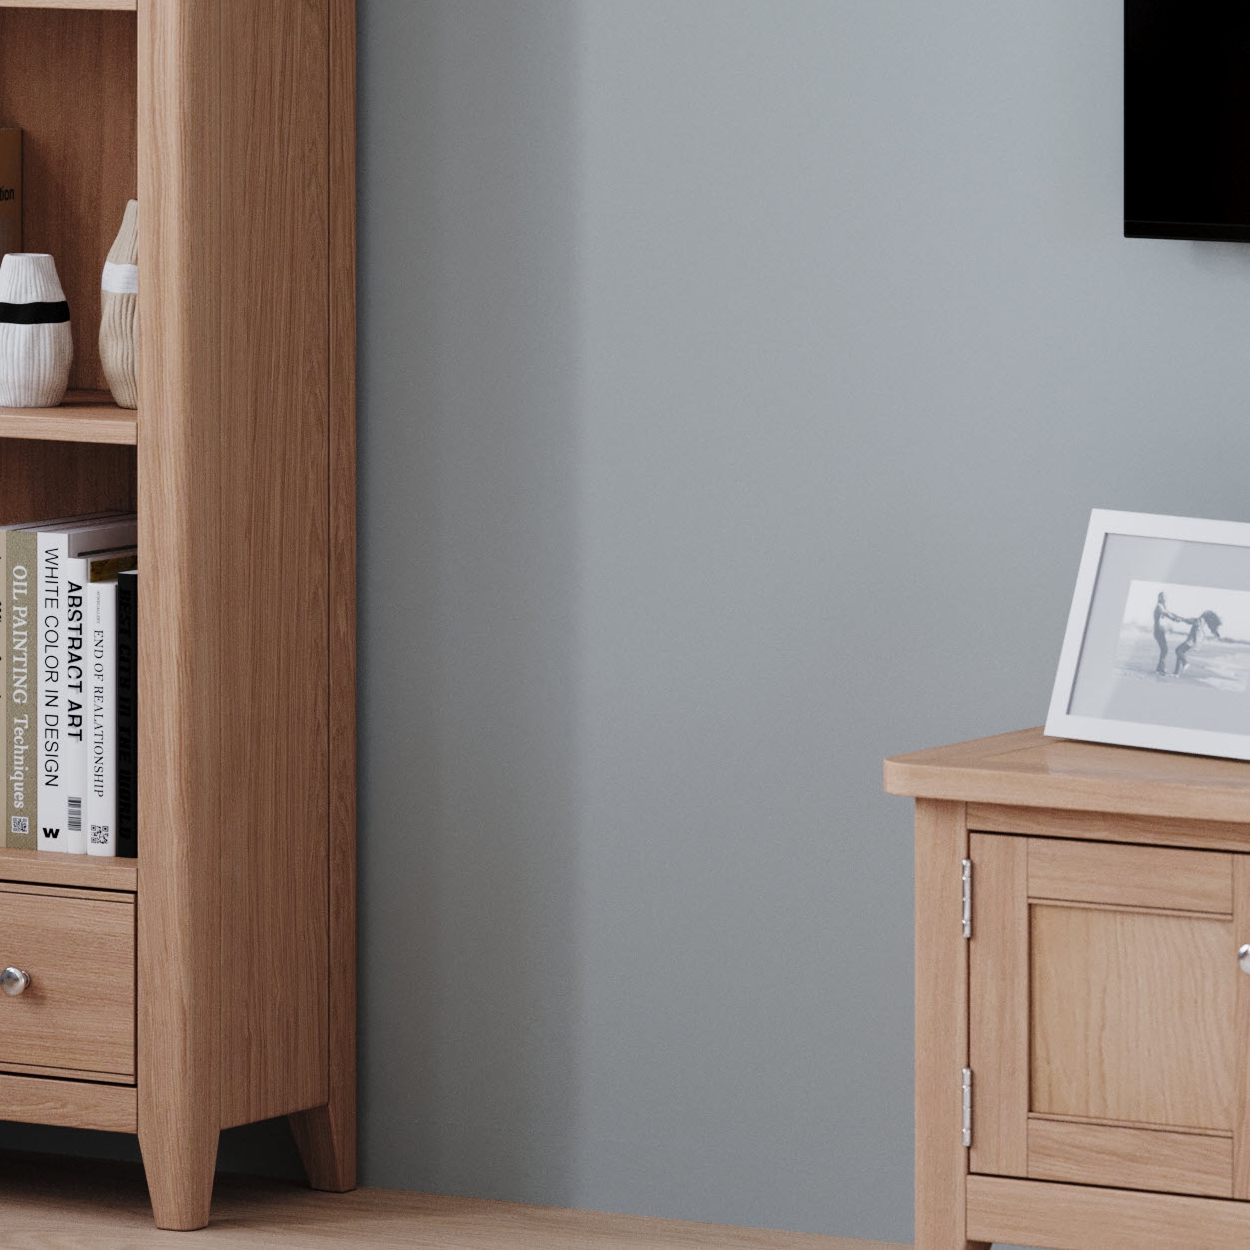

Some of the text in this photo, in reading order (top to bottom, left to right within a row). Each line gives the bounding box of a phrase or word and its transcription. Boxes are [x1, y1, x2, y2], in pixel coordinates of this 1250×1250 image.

[10, 565, 29, 809] OIL PAINTING Techniques
[44, 547, 59, 787] WHITE COLOR IN DESIGN
[67, 580, 83, 742] ABSTRACT ART
[93, 630, 104, 659] END
[93, 663, 104, 682] OF
[93, 686, 104, 798] REALATIONSHIP
